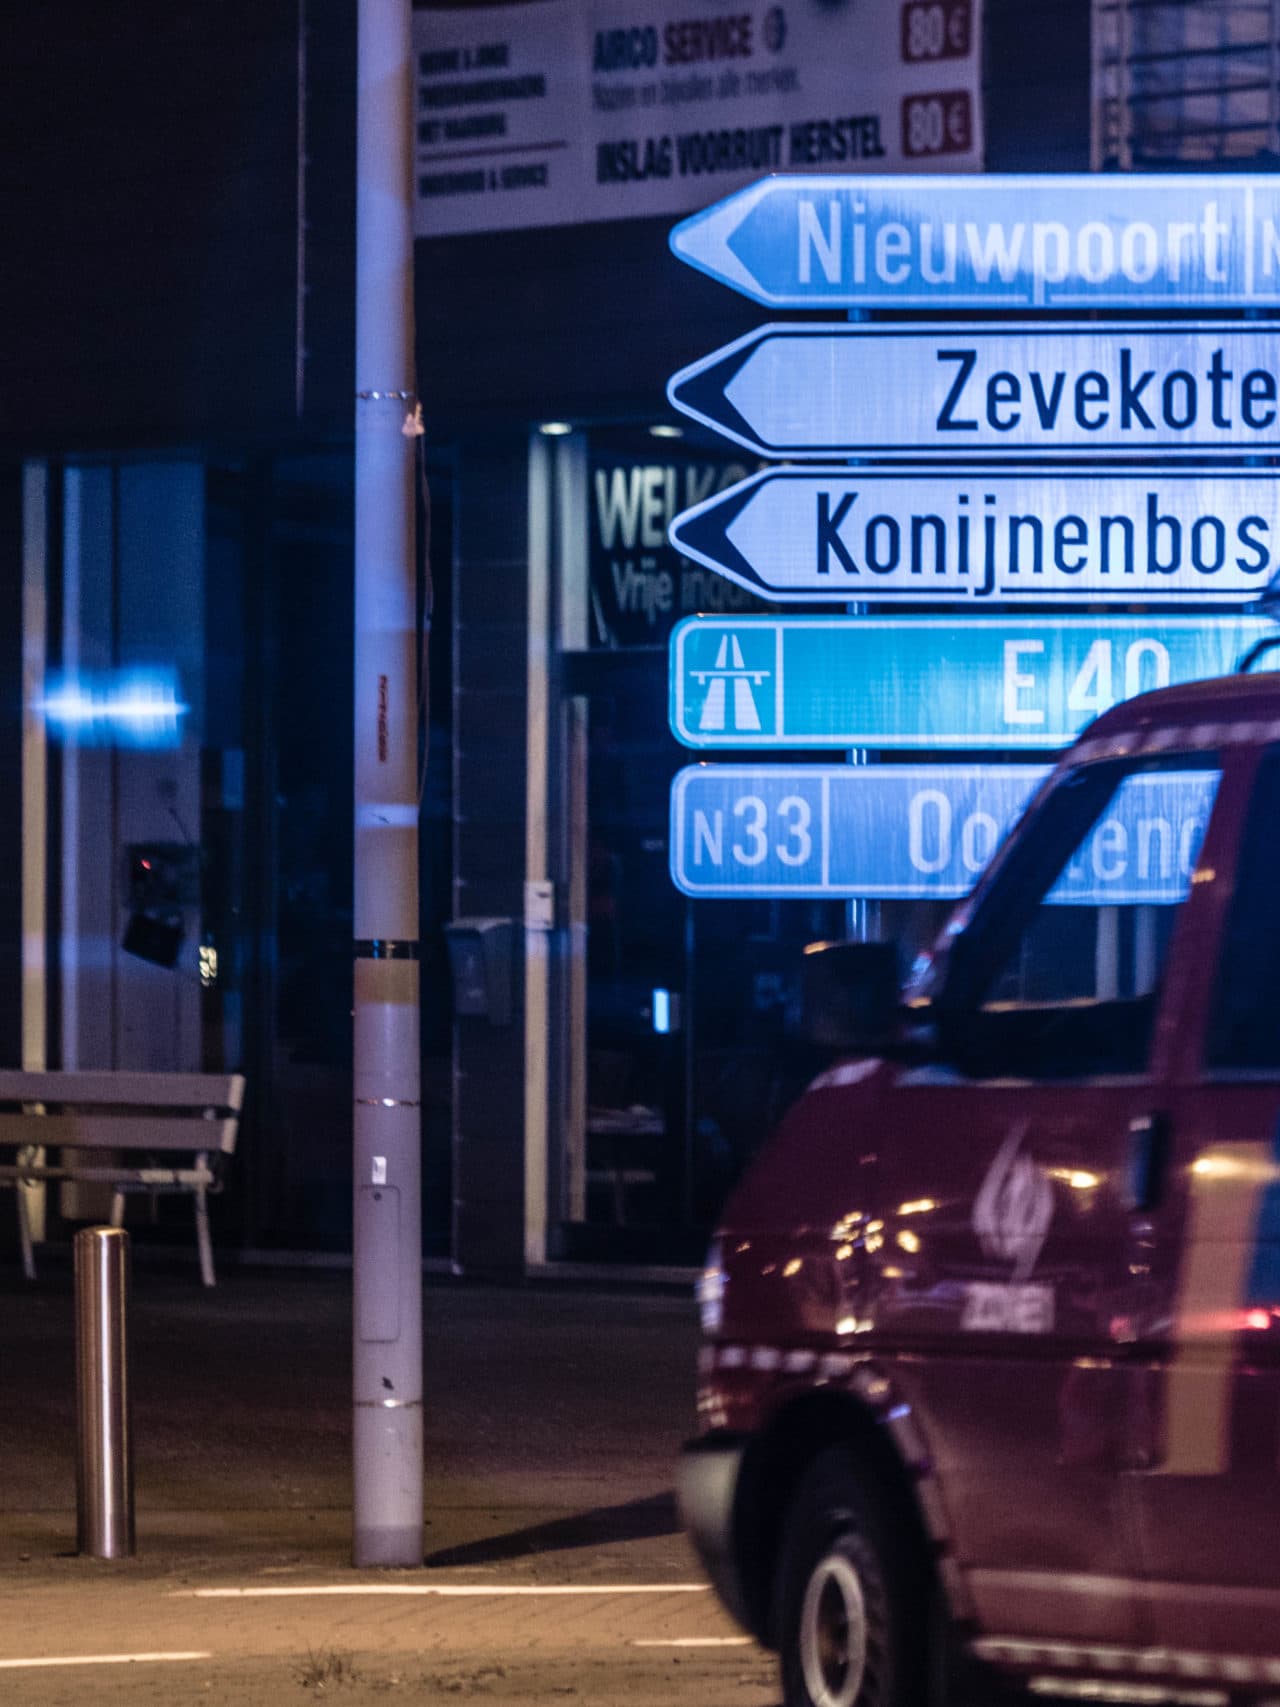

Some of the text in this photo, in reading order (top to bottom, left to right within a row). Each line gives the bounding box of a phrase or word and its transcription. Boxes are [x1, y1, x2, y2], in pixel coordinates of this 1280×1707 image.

[664, 14, 753, 66] SERVICE
[596, 135, 672, 184] INSLAG
[675, 125, 784, 177] VOORRUIT
[789, 114, 887, 165] HERSTEL
[798, 199, 1228, 305] Nieuwpoort
[935, 347, 1279, 432] Zevekote
[815, 491, 1271, 597] Konijnenbos
[693, 788, 1205, 882] N33 Ooen
